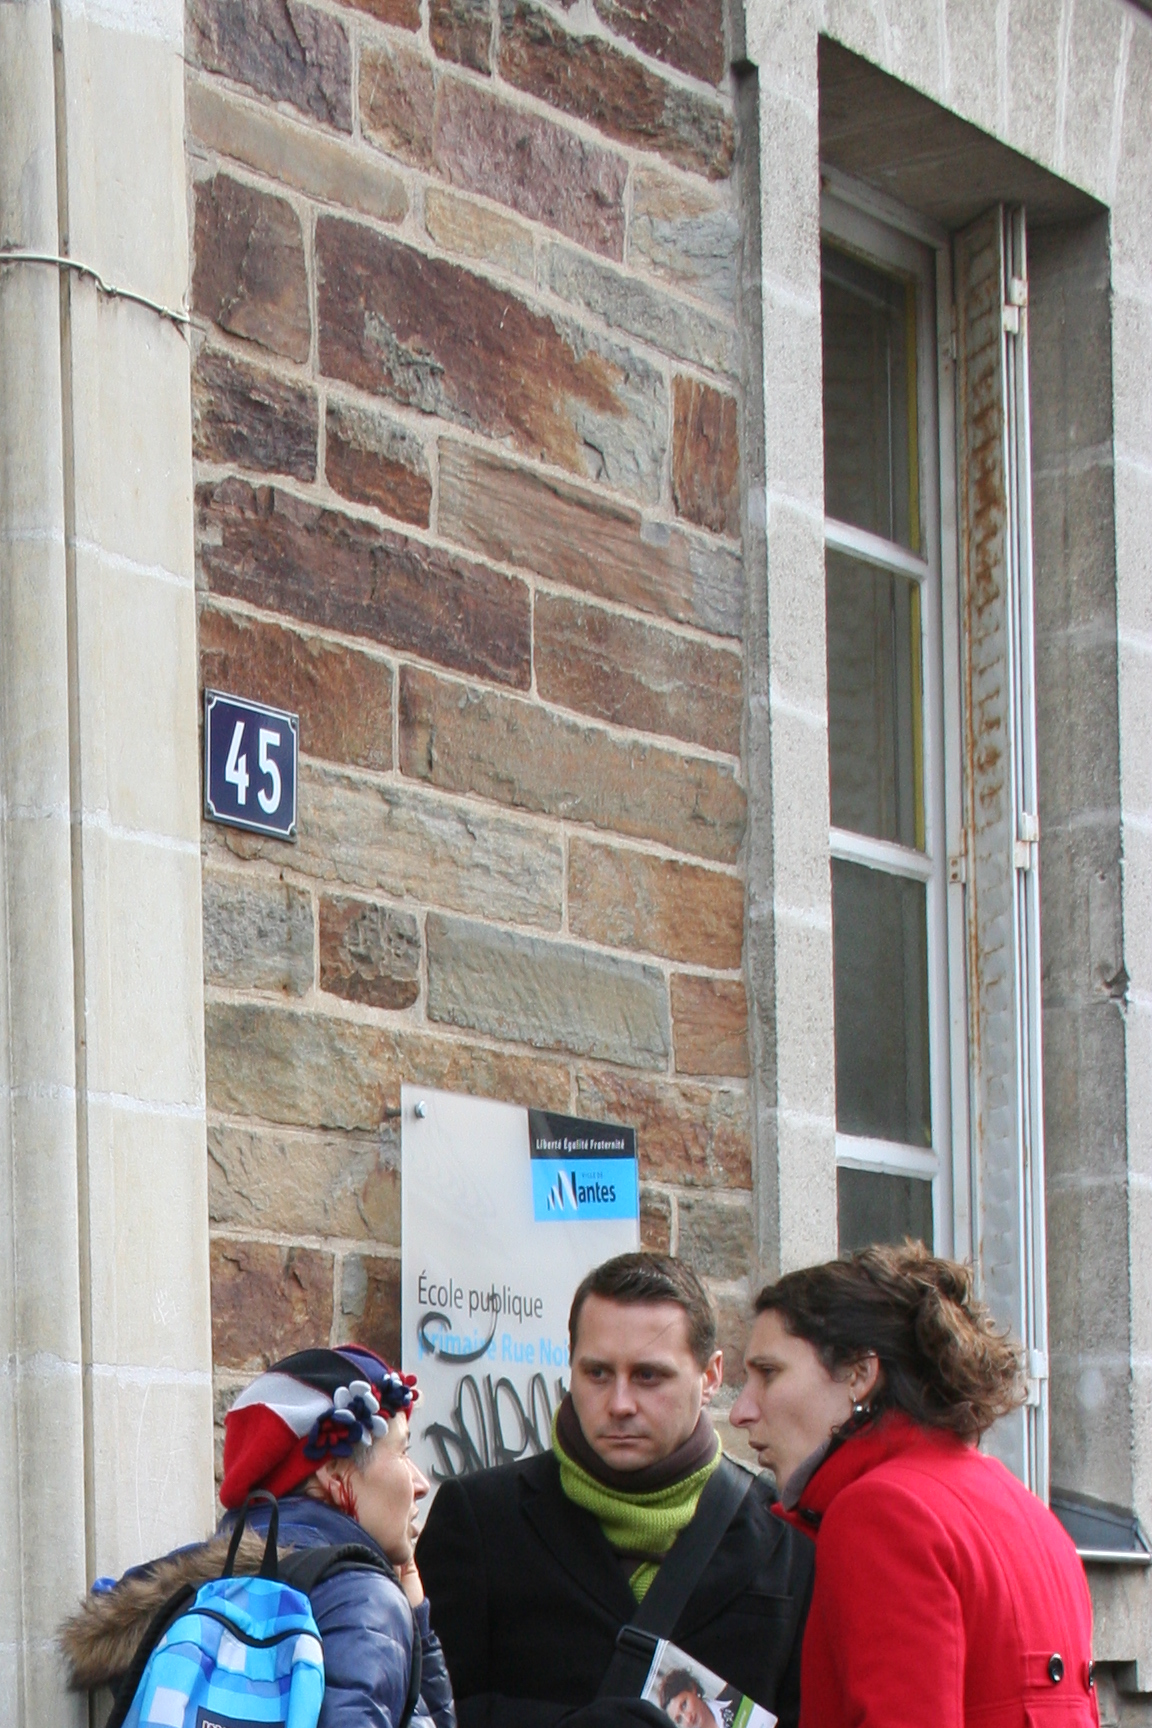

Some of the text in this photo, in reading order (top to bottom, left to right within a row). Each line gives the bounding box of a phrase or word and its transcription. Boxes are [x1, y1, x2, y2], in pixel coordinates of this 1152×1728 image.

[225, 721, 282, 814] 45
[536, 1138, 562, 1150] Liberté
[589, 1138, 625, 1151] Fraternité
[547, 1170, 617, 1211] Nantes
[418, 1269, 543, 1324] École publique
[502, 1333, 535, 1363] Rue
[540, 1337, 569, 1367] Noi
